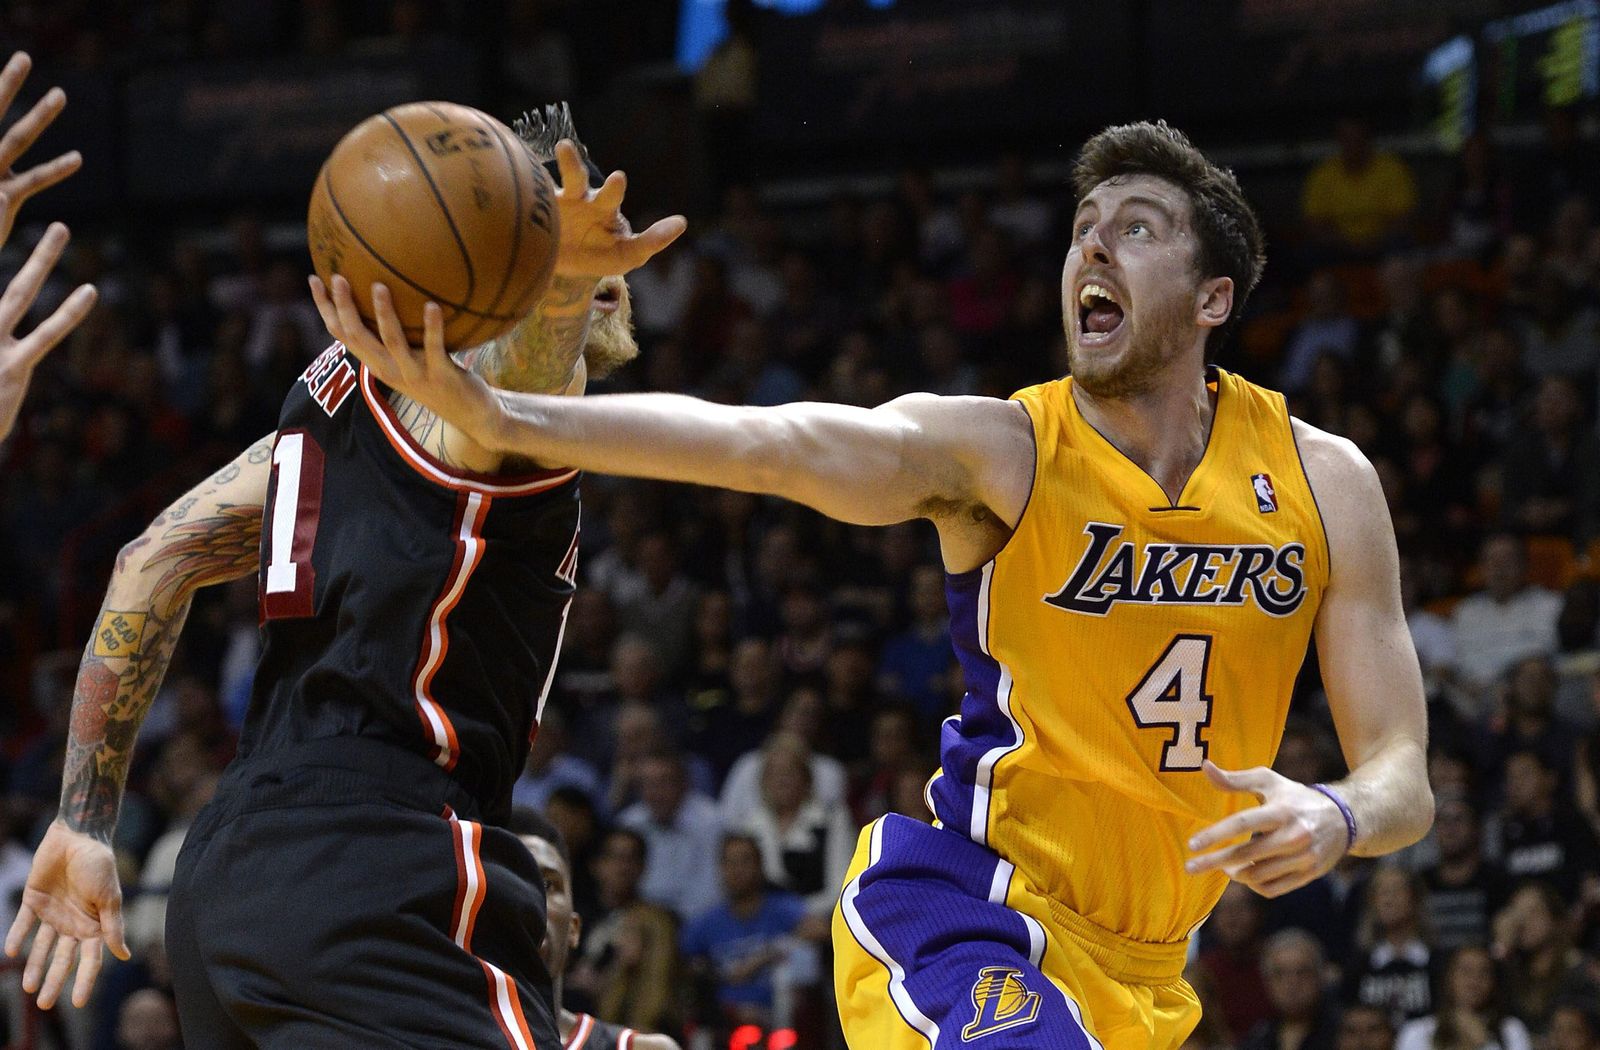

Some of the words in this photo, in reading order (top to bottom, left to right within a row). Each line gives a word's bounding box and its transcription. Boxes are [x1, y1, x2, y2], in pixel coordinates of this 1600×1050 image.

[298, 340, 357, 418] SEN
[1041, 521, 1308, 619] LAKERS
[101, 628, 119, 651] END
[111, 615, 137, 643] DEAD
[1125, 633, 1213, 772] 4
